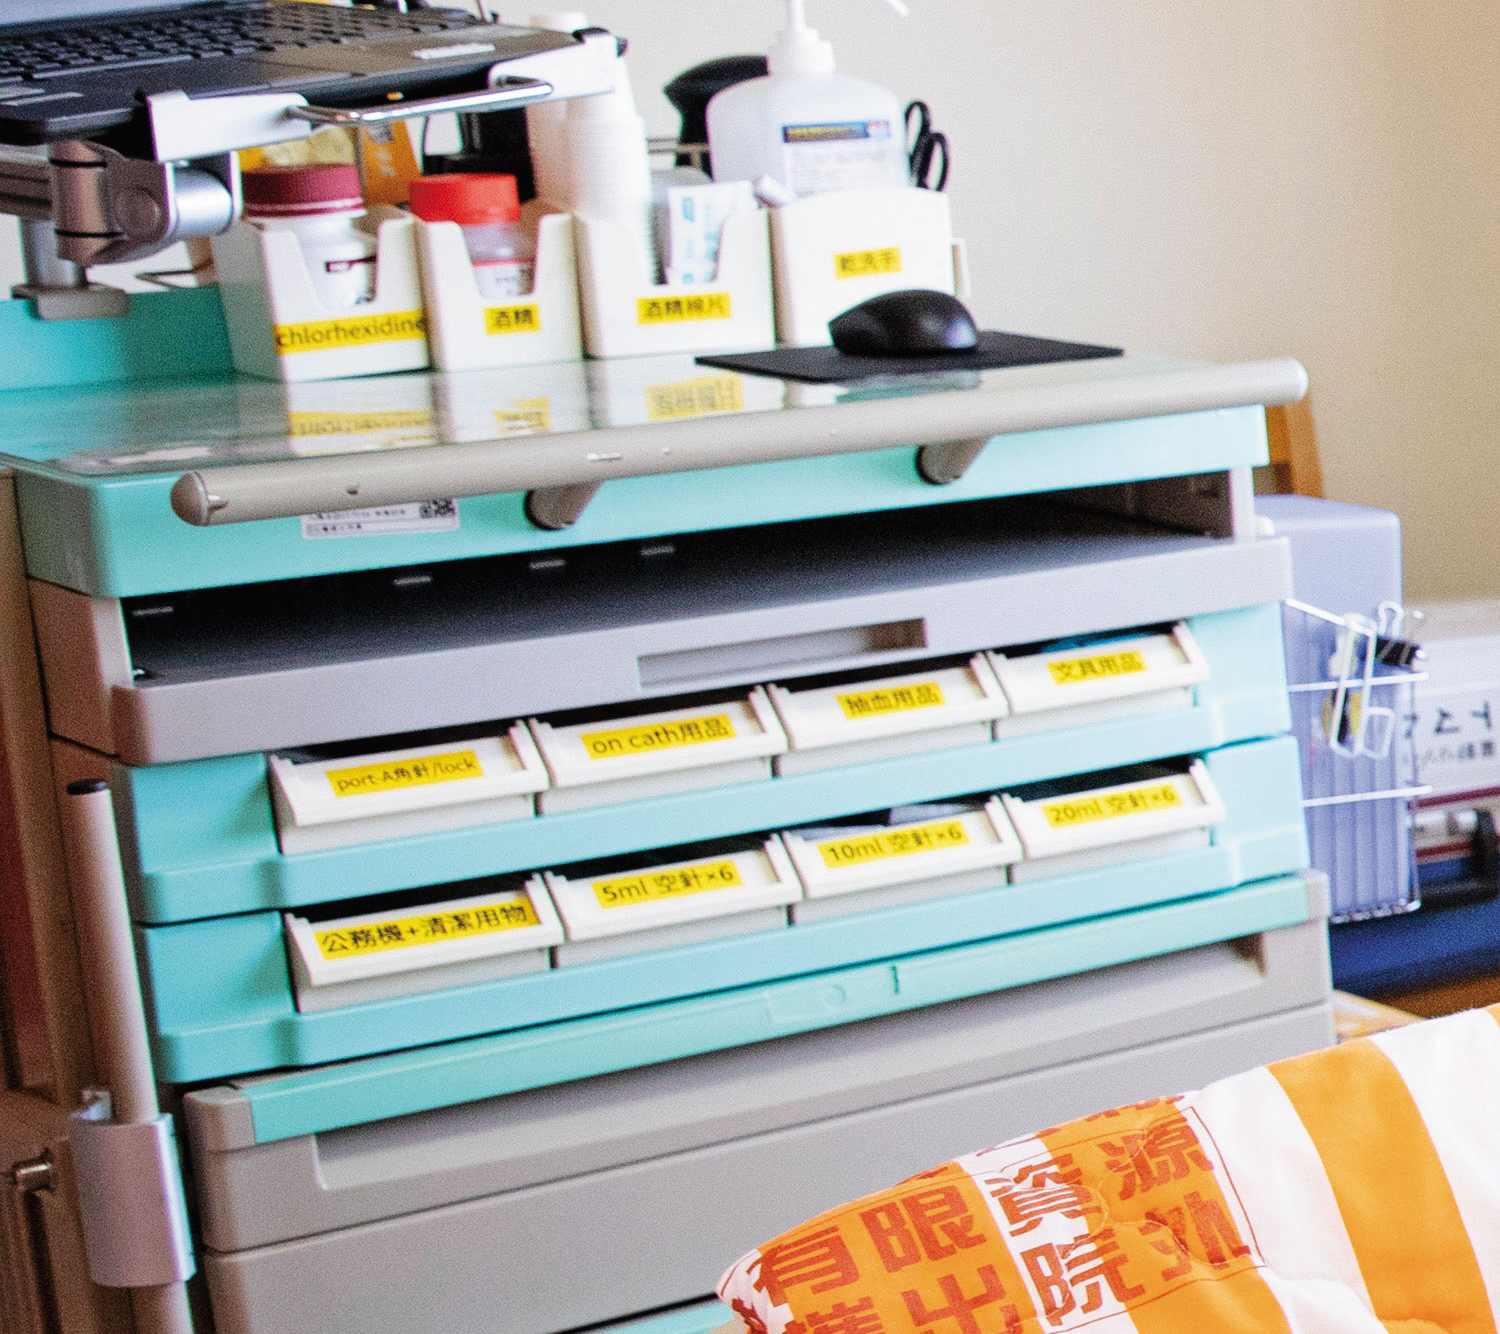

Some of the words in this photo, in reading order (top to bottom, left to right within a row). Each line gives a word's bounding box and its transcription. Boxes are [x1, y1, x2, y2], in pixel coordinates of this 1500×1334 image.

[275, 313, 427, 348] chlorhexidine
[493, 307, 533, 328] 酒精
[1059, 654, 1144, 679] 文具用品
[845, 687, 940, 715] 抽血用品
[592, 736, 622, 754] on
[629, 717, 729, 748] cath用品
[1054, 800, 1103, 822] 20ml
[829, 832, 883, 861] 10ml
[603, 880, 649, 902] 5ml
[321, 906, 528, 953] 公務機+清潔用物
[747, 1116, 1214, 1307] 有限資源
